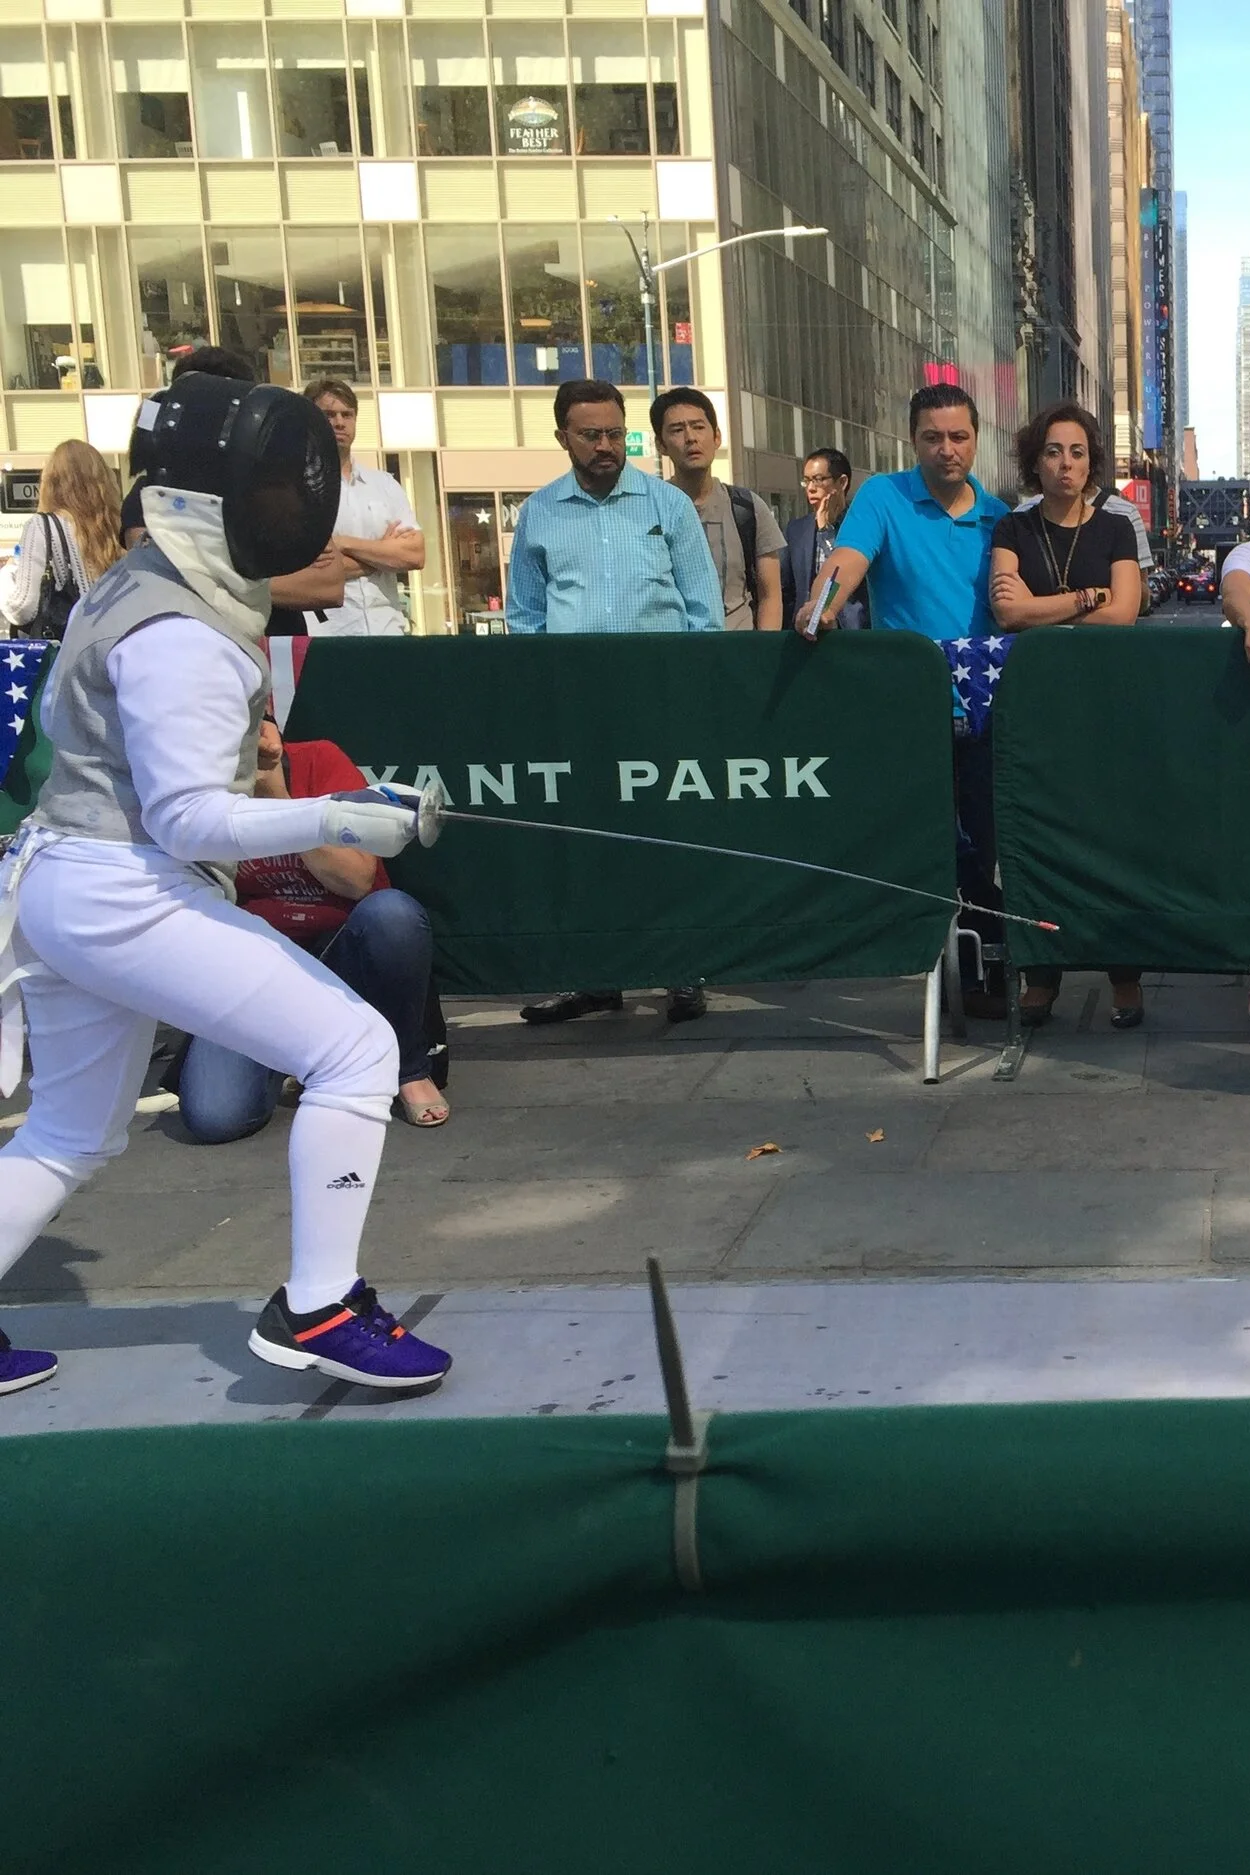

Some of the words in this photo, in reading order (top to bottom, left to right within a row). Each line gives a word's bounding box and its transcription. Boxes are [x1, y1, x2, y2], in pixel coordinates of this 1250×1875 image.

[509, 128, 559, 138] FEATHER
[522, 138, 547, 147] BEST
[616, 756, 832, 802] PARK
[262, 853, 308, 870] UNITE
